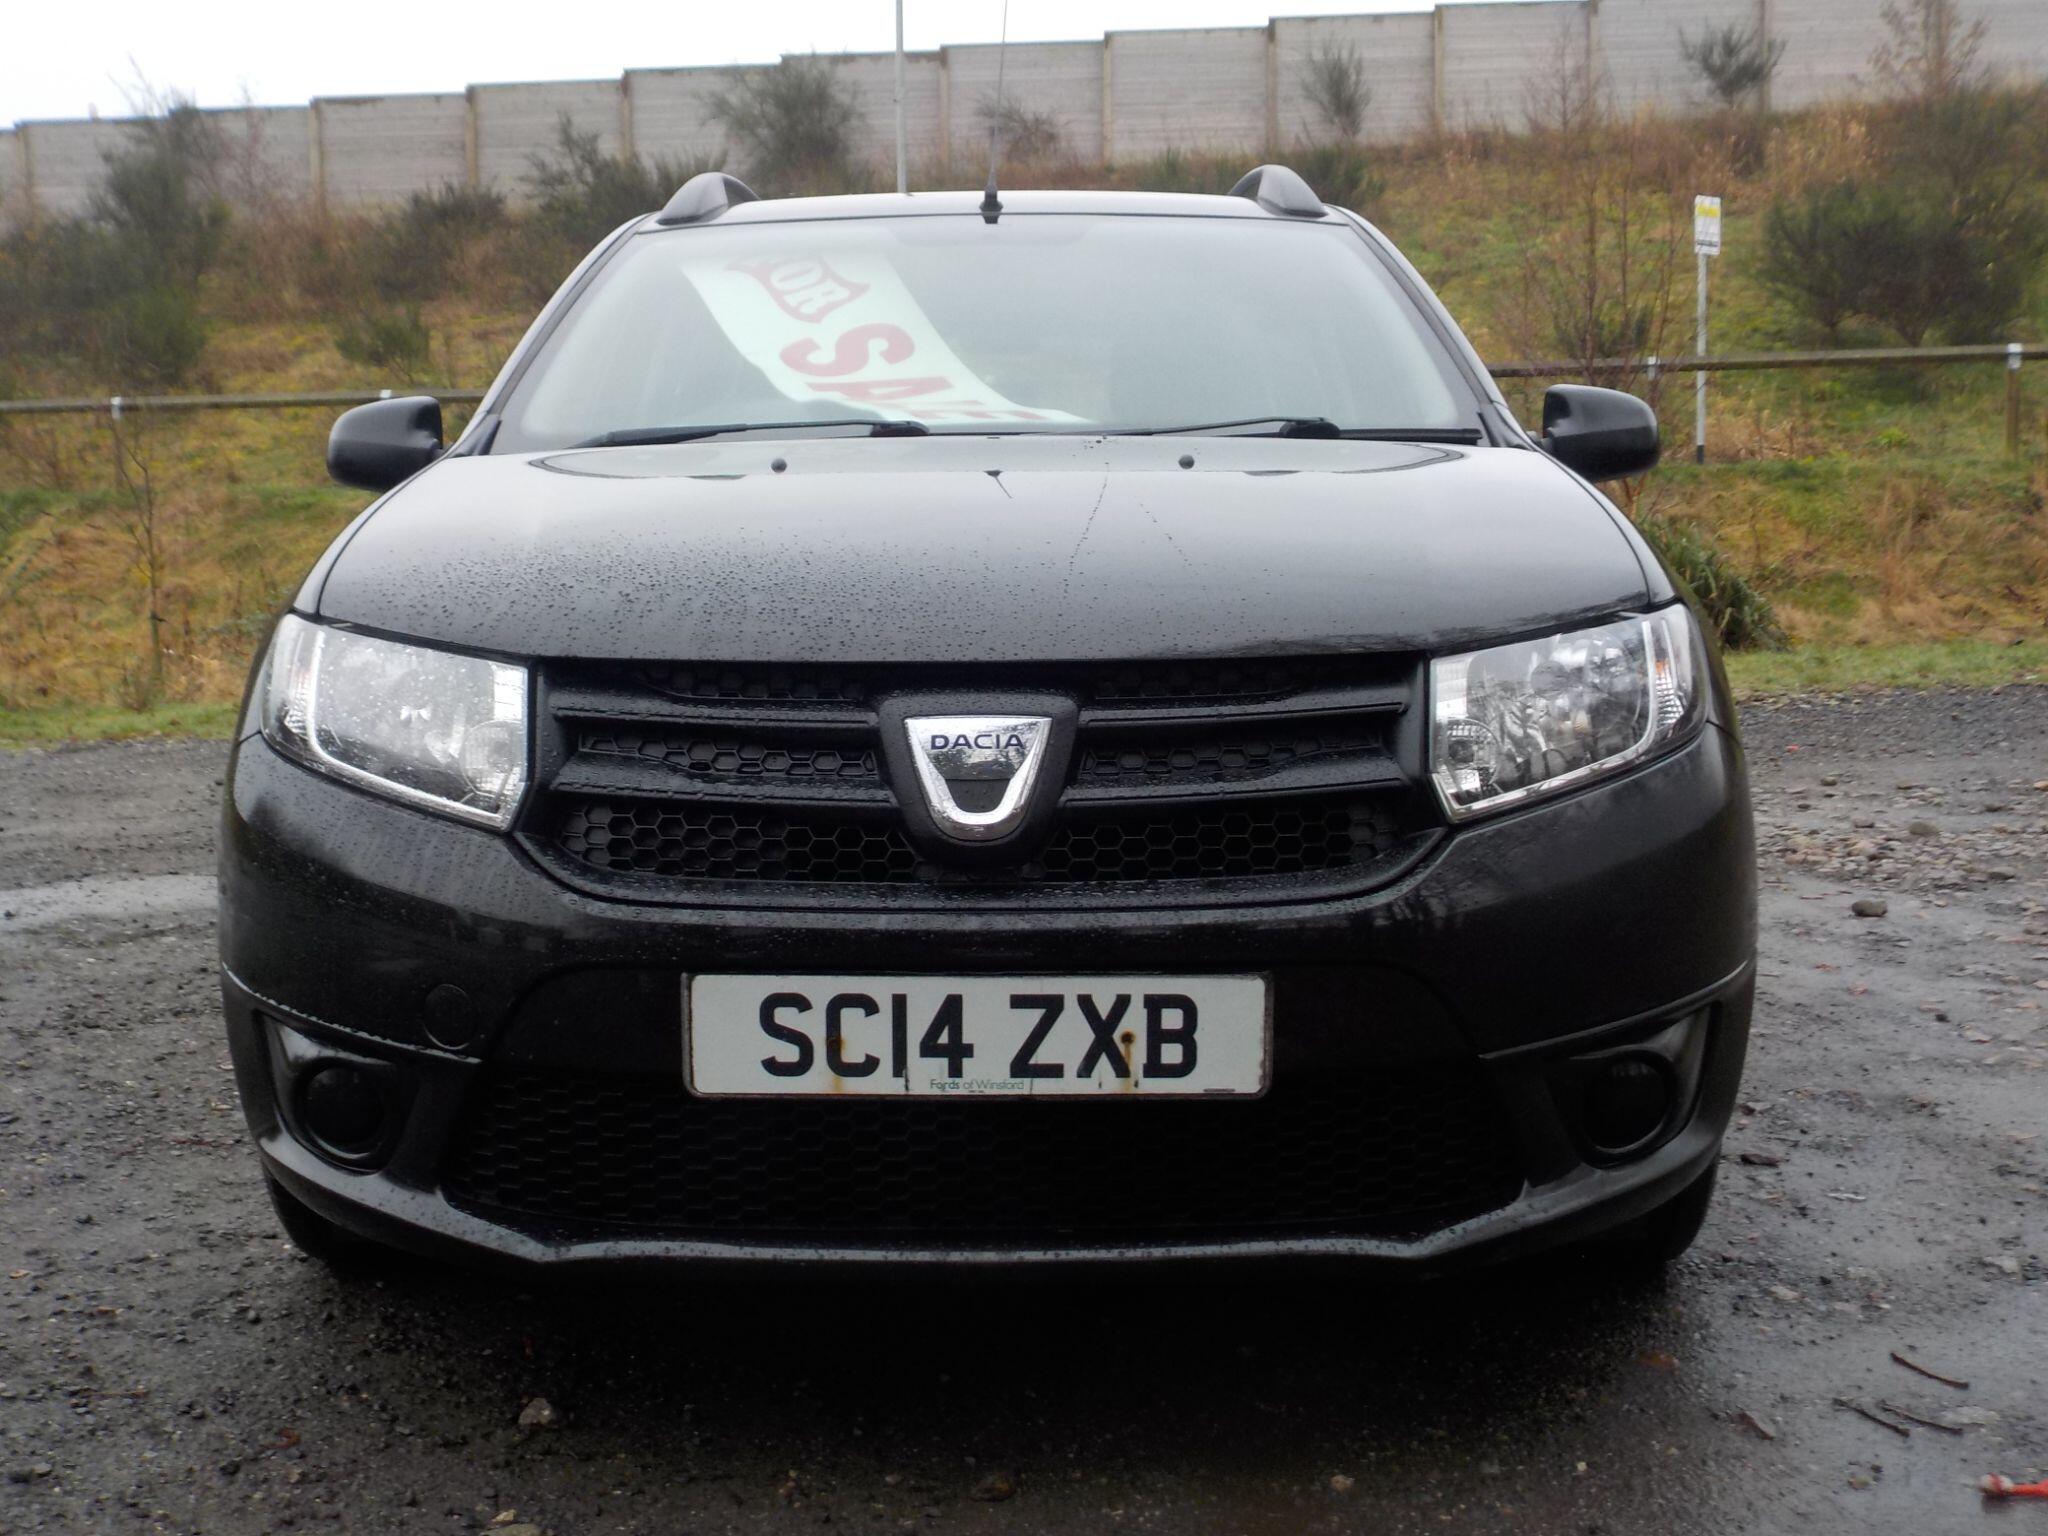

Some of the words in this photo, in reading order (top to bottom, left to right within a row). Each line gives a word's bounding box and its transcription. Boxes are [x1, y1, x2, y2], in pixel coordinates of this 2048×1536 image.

[931, 734, 1025, 750] DACIA
[759, 992, 975, 1079] SC14
[1009, 993, 1199, 1079] ZXB
[963, 1079, 975, 1090] of
